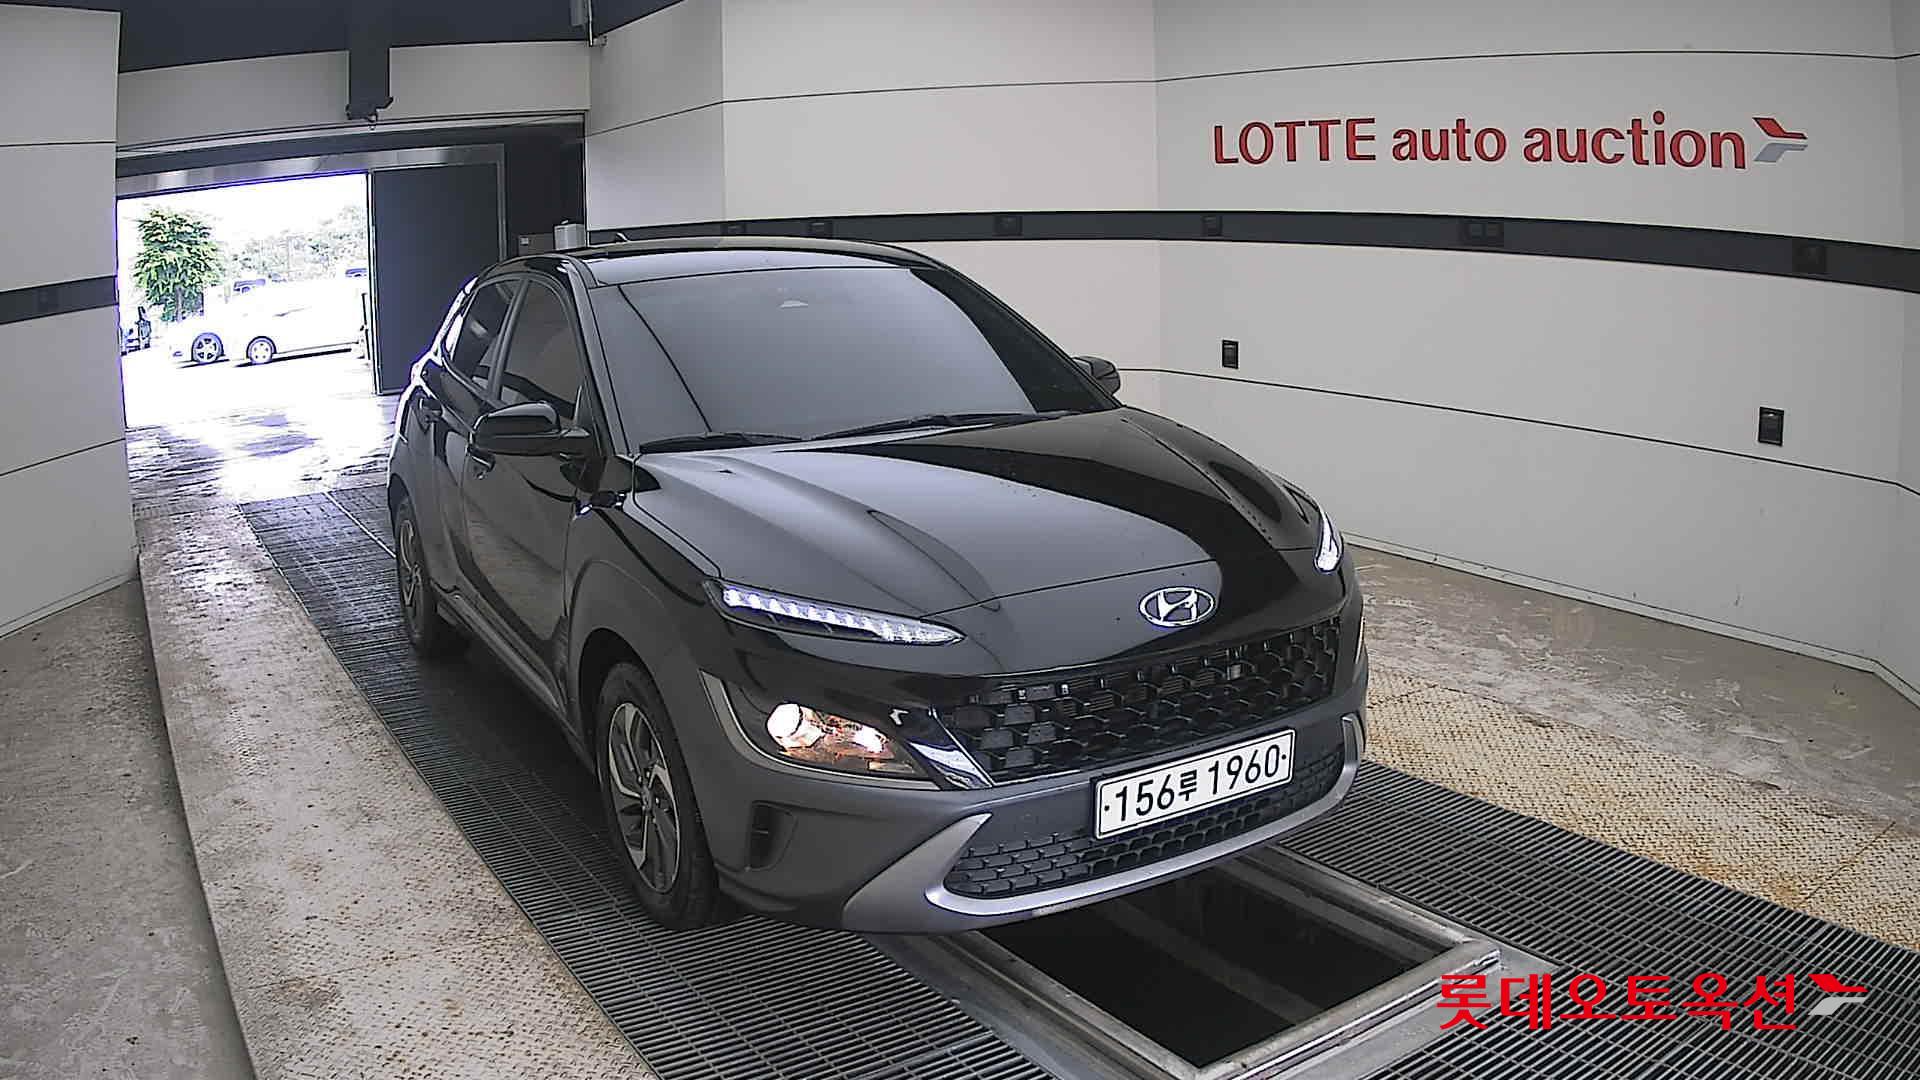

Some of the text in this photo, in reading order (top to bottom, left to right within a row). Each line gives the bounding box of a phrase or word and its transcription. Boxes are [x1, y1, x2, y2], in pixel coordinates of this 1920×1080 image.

[1214, 111, 1747, 169] LOTTE auto auction
[1115, 744, 1280, 822] 156루 1960
